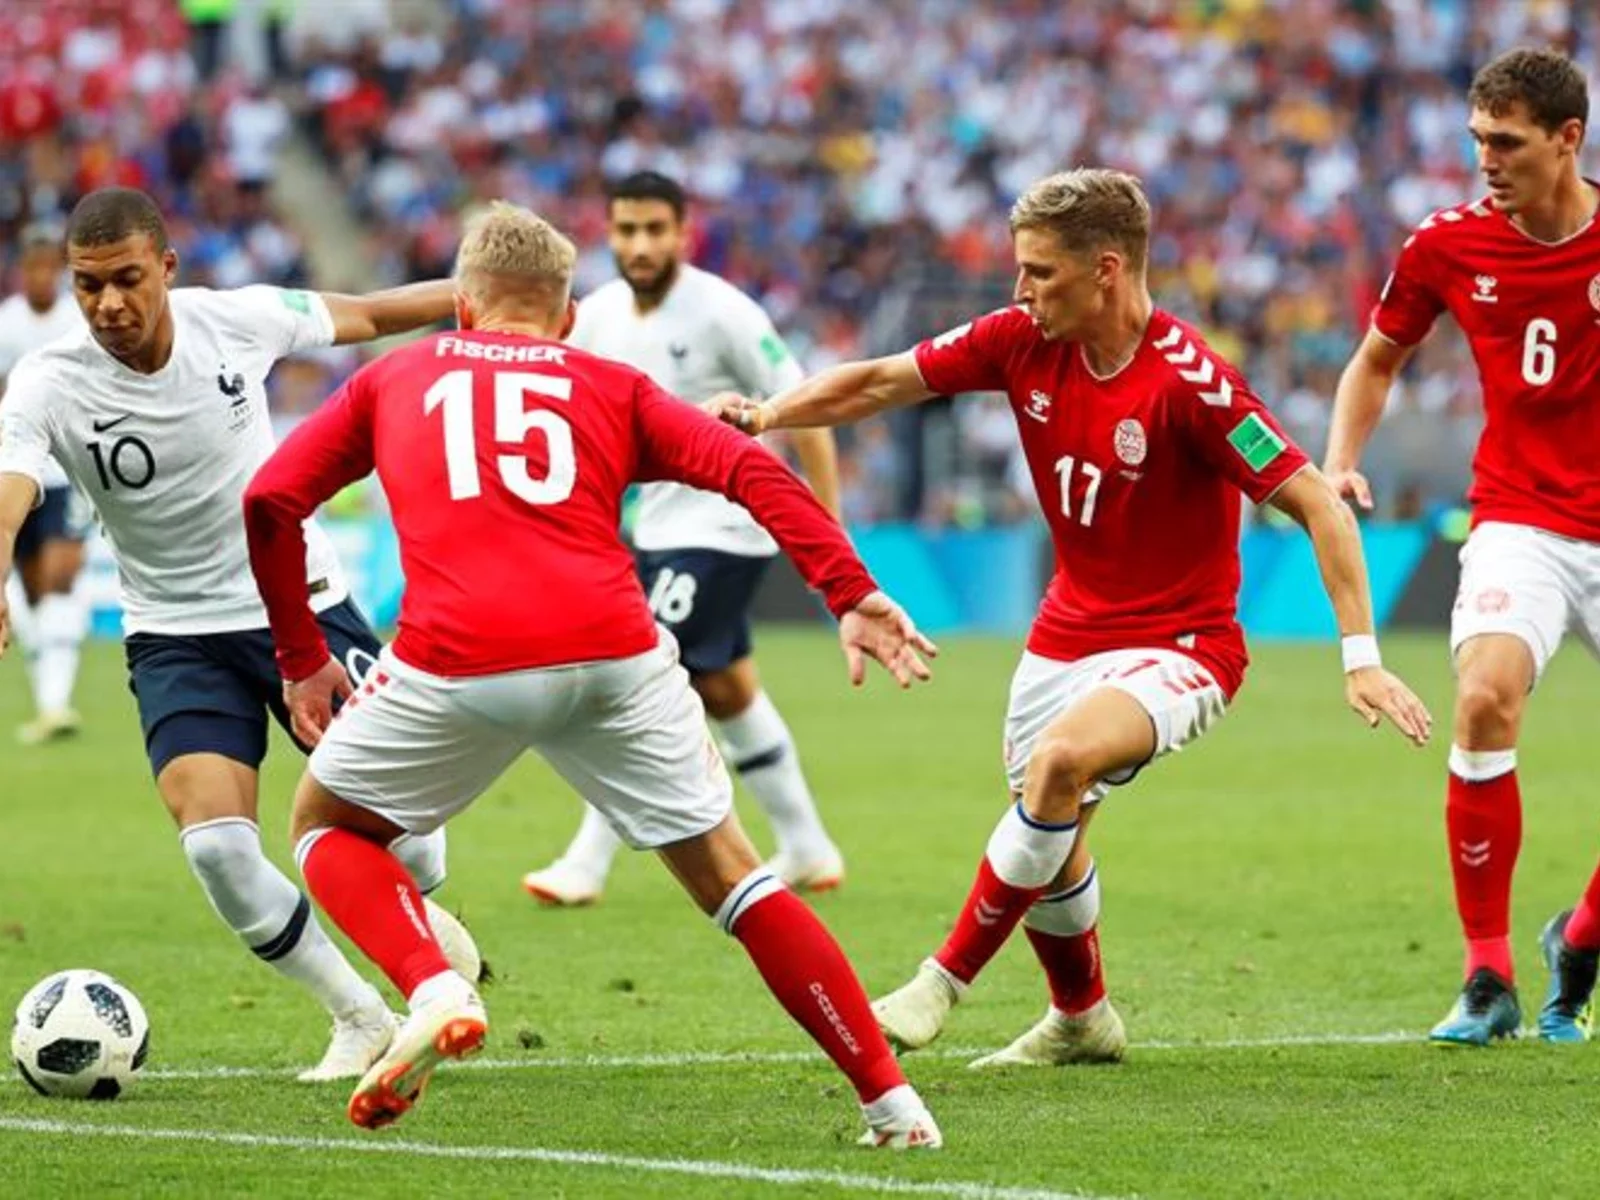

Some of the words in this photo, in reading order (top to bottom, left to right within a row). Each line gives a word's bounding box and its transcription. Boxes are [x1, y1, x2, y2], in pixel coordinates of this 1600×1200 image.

[435, 336, 567, 366] FISCHER
[1521, 317, 1558, 387] 6
[86, 435, 156, 491] 10
[423, 369, 578, 506] 15
[1053, 455, 1102, 528] 17
[647, 566, 697, 624] 18
